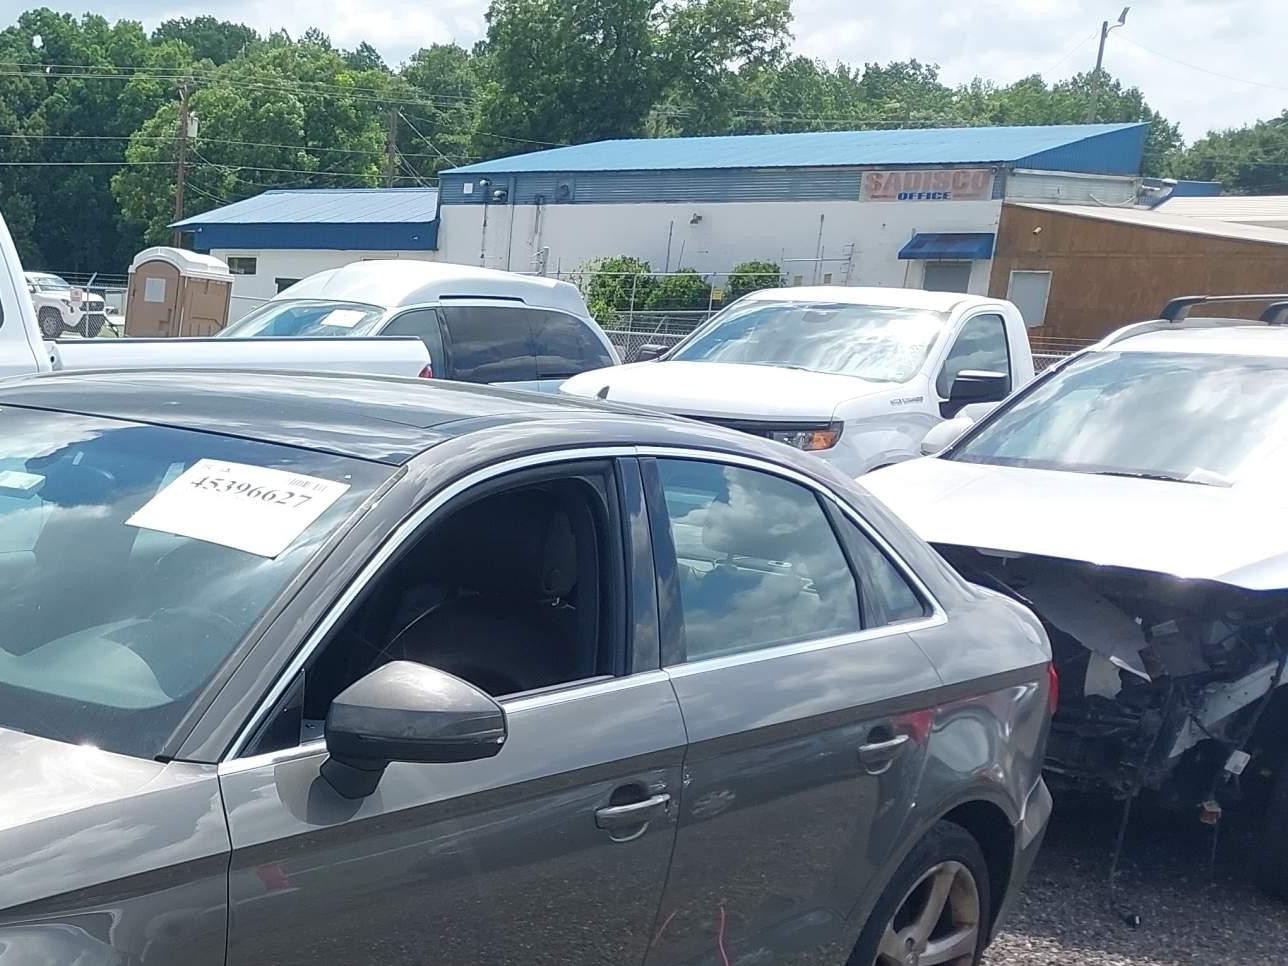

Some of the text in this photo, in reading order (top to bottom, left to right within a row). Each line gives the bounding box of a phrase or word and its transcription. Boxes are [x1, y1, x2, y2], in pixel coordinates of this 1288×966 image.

[865, 170, 991, 191] SADISCO
[897, 191, 952, 200] OFFICE
[191, 476, 313, 508] 45396627
